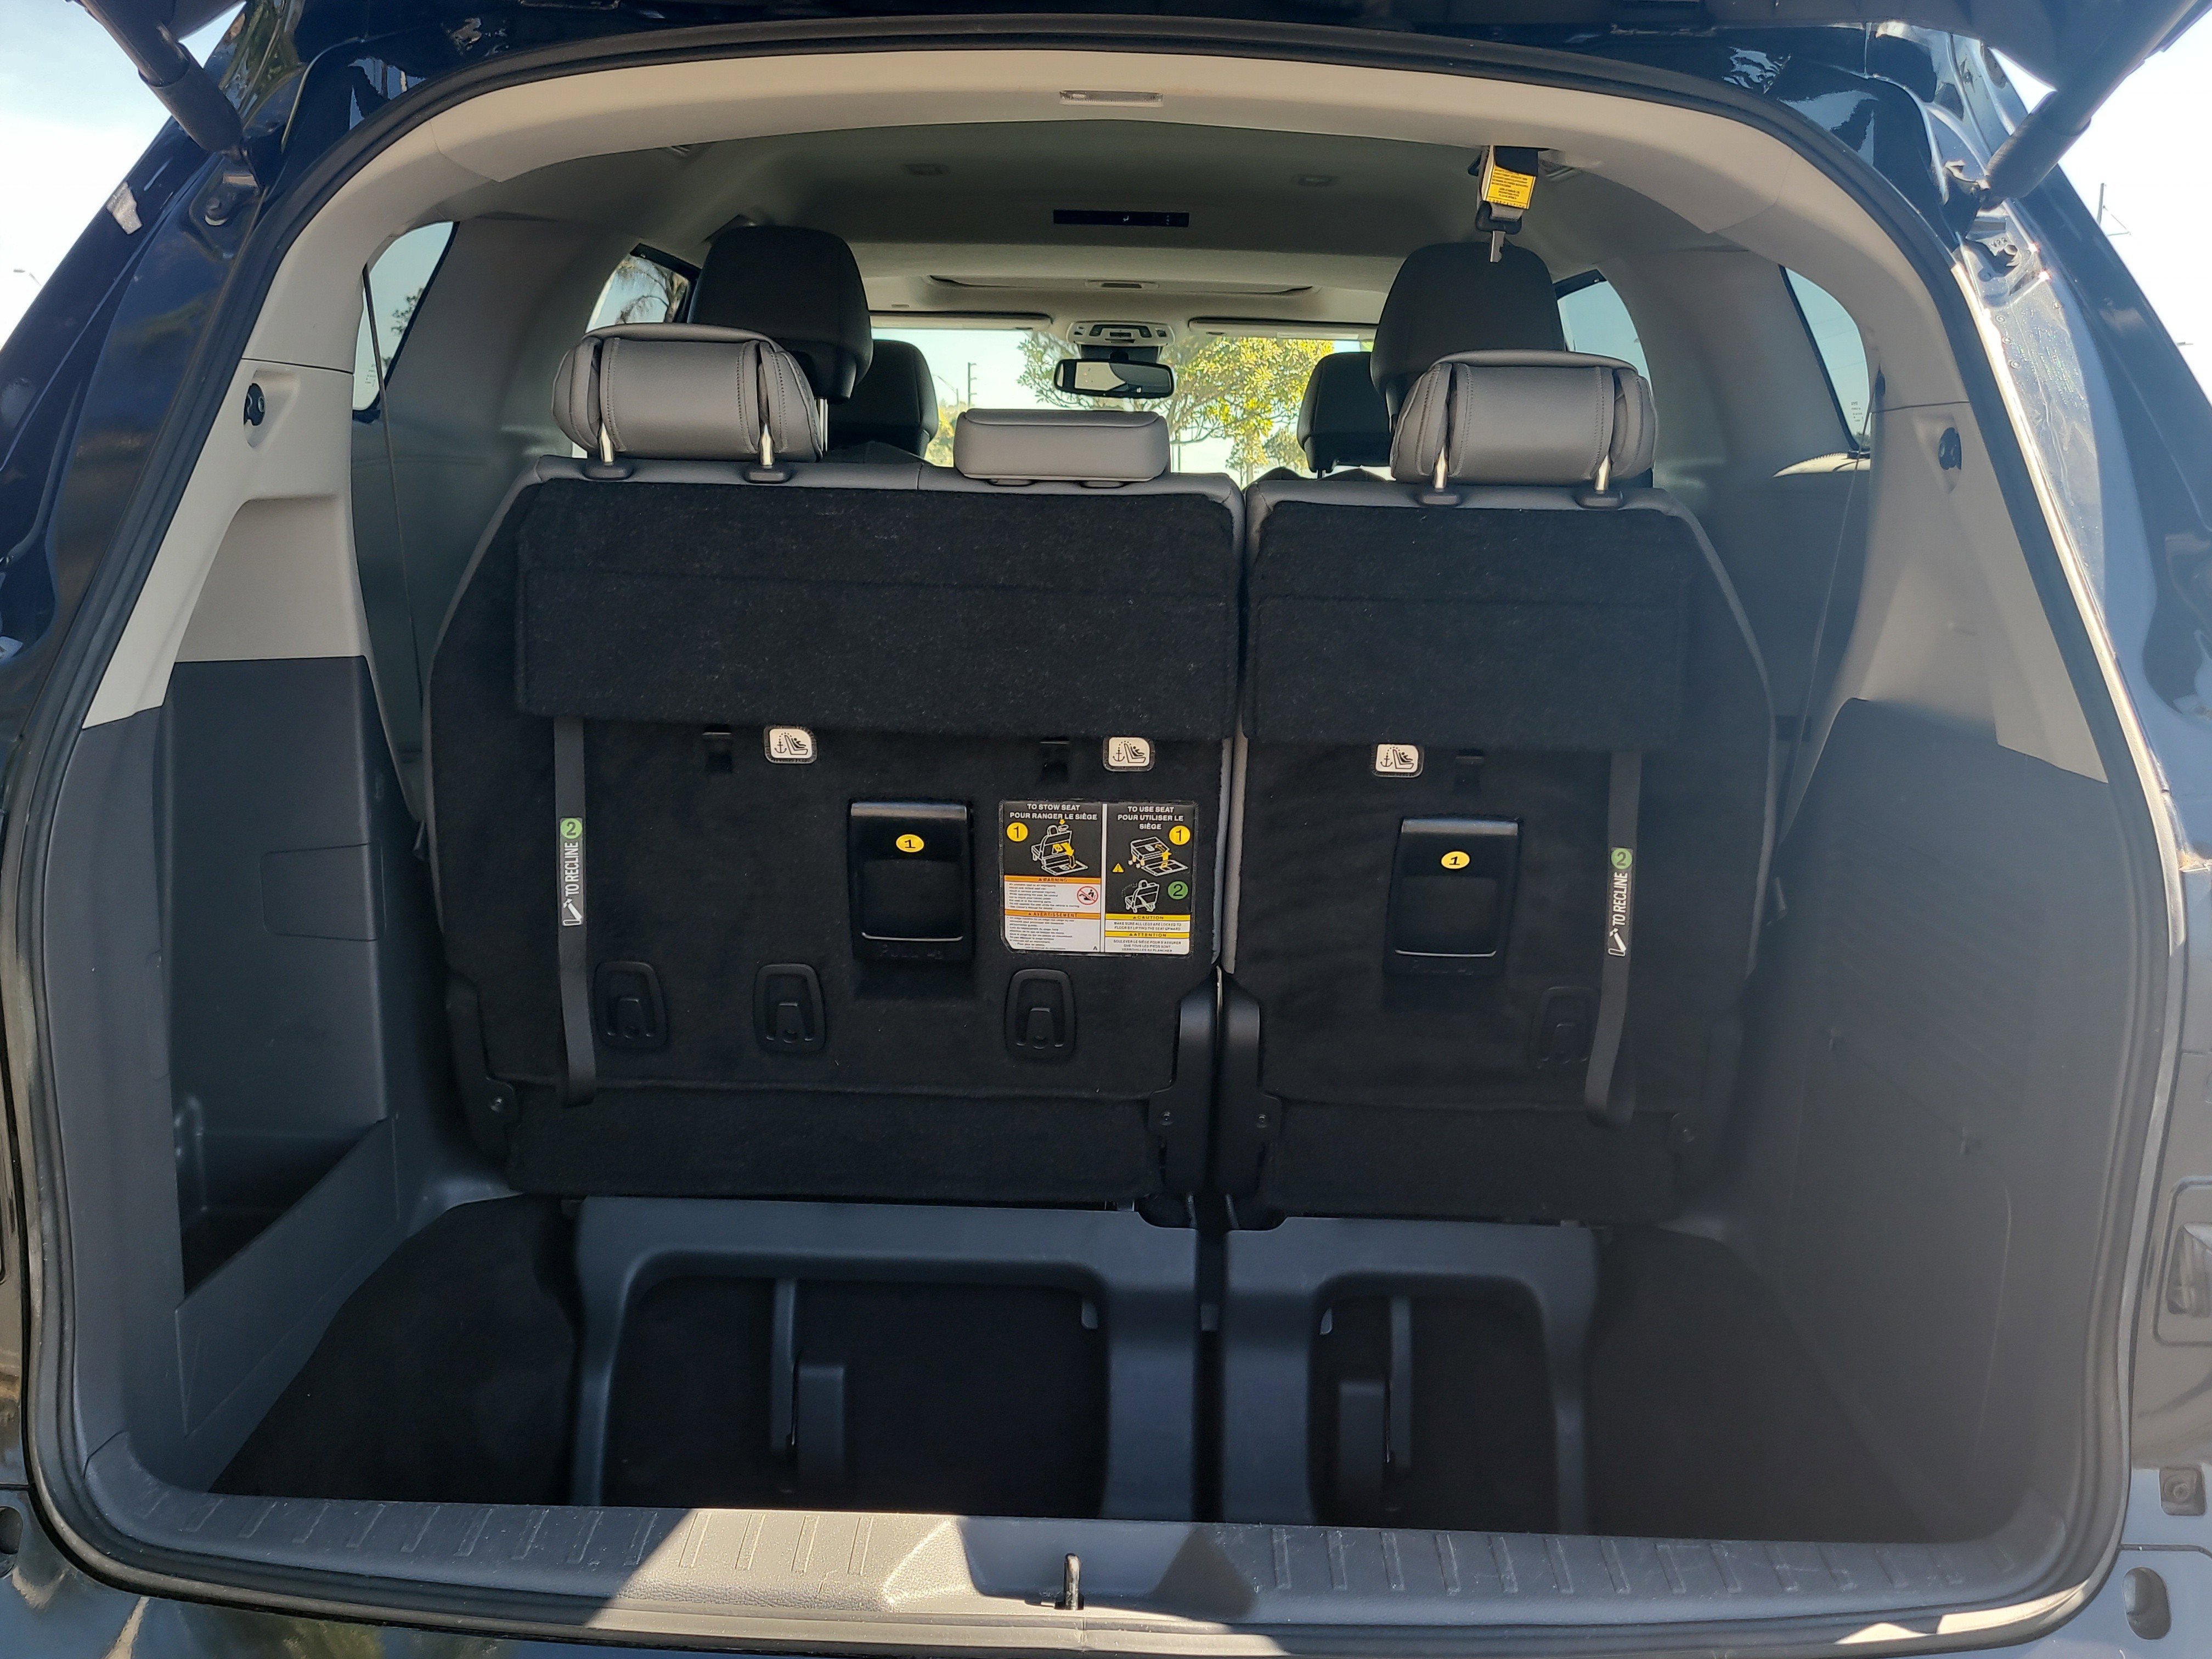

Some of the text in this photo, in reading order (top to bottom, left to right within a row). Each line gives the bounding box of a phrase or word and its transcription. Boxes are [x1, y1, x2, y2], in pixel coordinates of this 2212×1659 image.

[566, 821, 576, 836] 2
[1013, 826, 1019, 838] 1
[1176, 829, 1181, 842] 1
[905, 839, 916, 849] 1
[1449, 856, 1460, 865] 1
[1616, 851, 1626, 866] 2
[565, 842, 579, 897] TO RECLINE
[1173, 884, 1183, 896] 2
[1612, 872, 1628, 926] TO RECLINE
